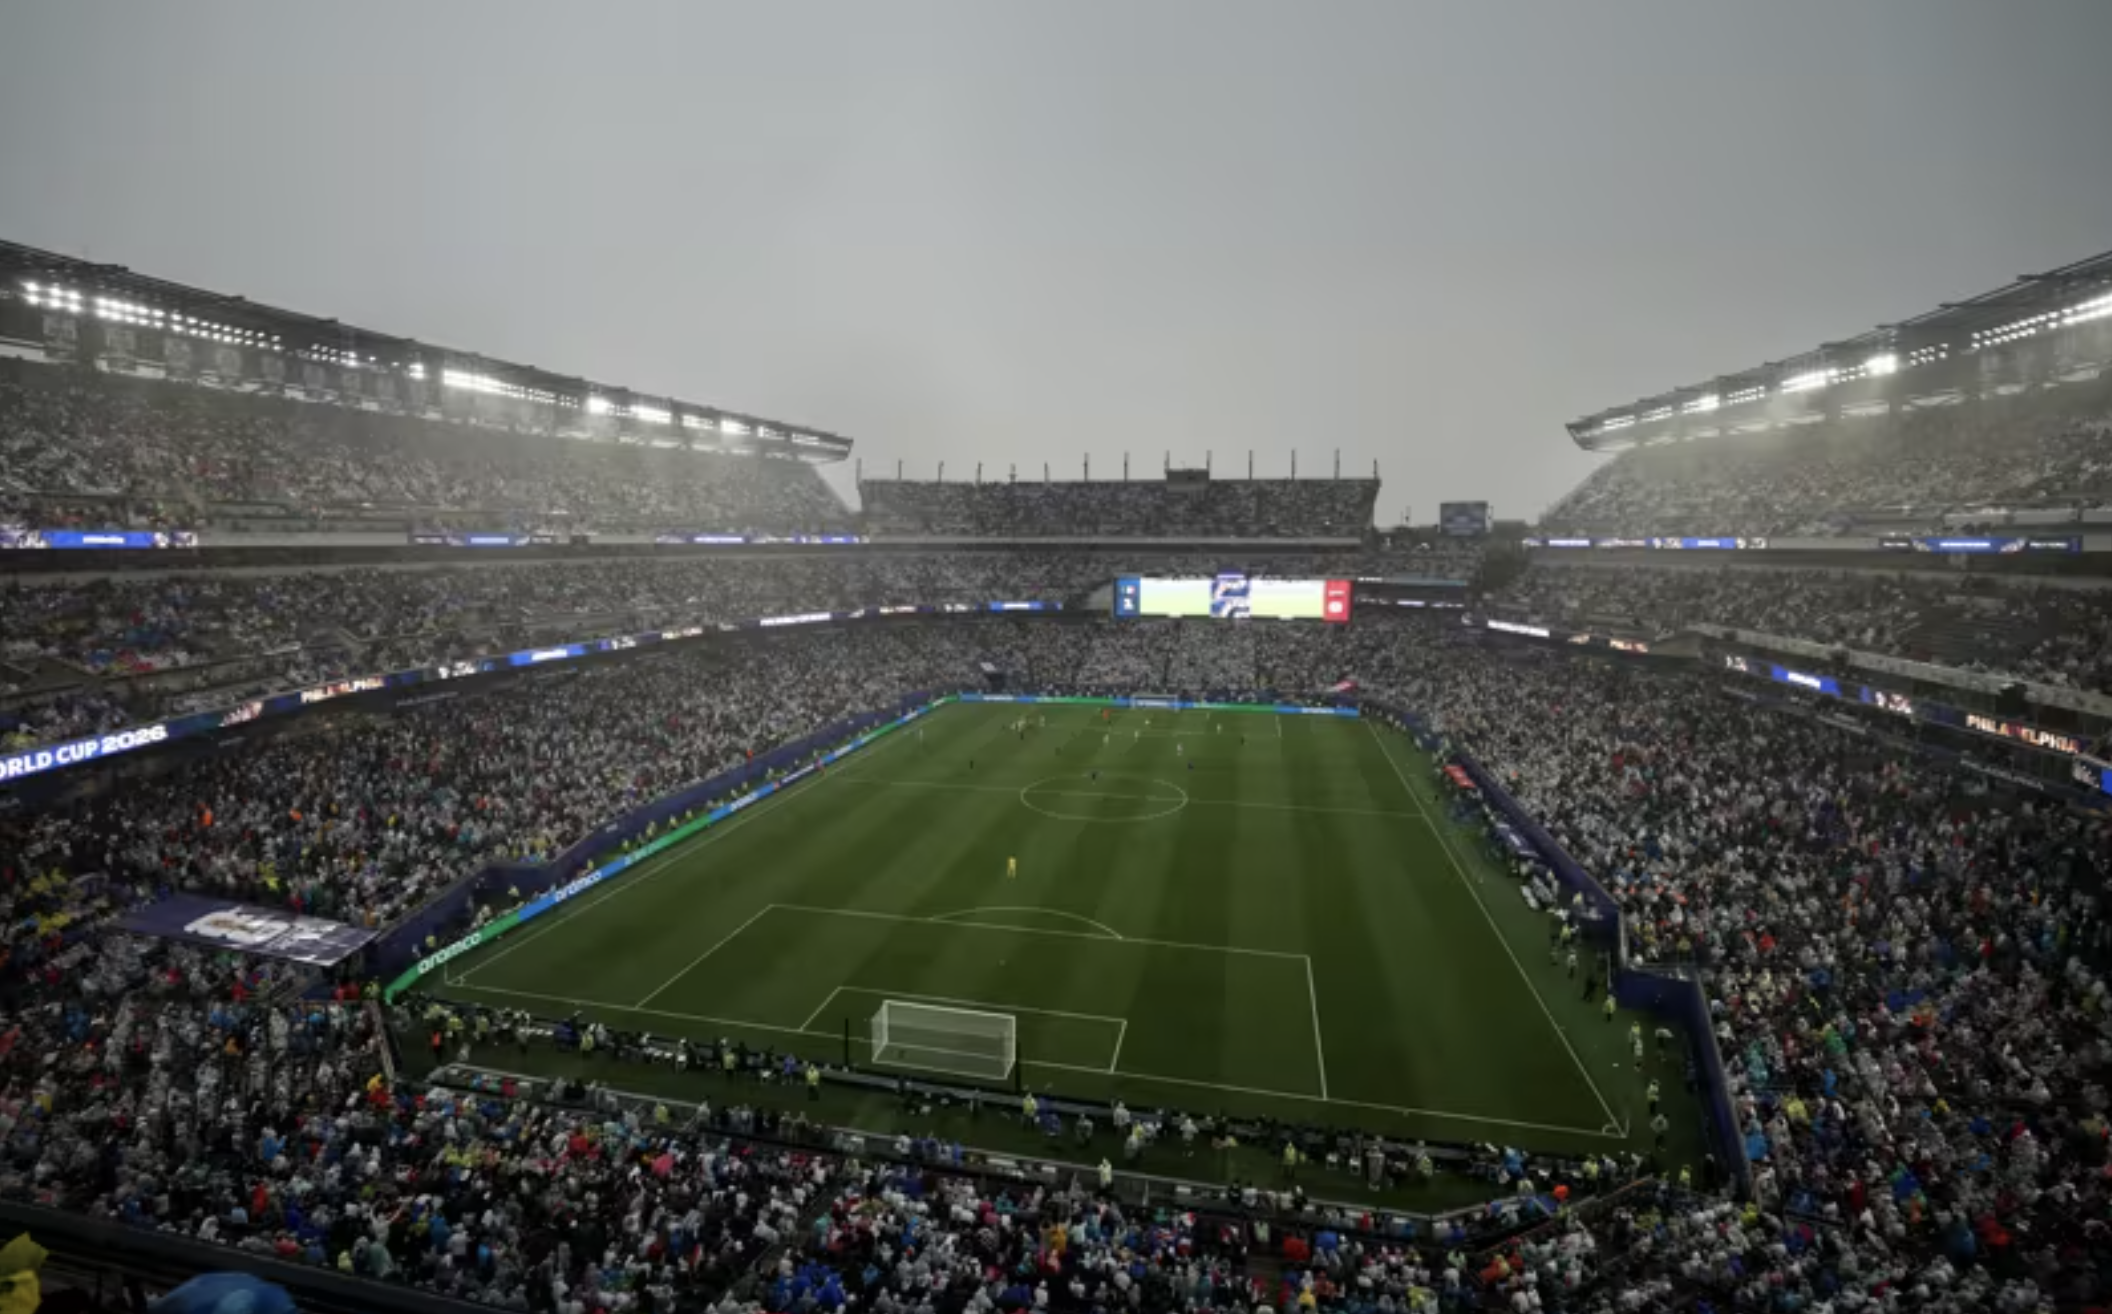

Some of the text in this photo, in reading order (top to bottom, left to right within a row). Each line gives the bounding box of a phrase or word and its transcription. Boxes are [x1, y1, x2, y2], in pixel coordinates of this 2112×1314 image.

[56, 740, 98, 764] CUP
[101, 725, 168, 753] 2026
[417, 932, 481, 974] aramco
